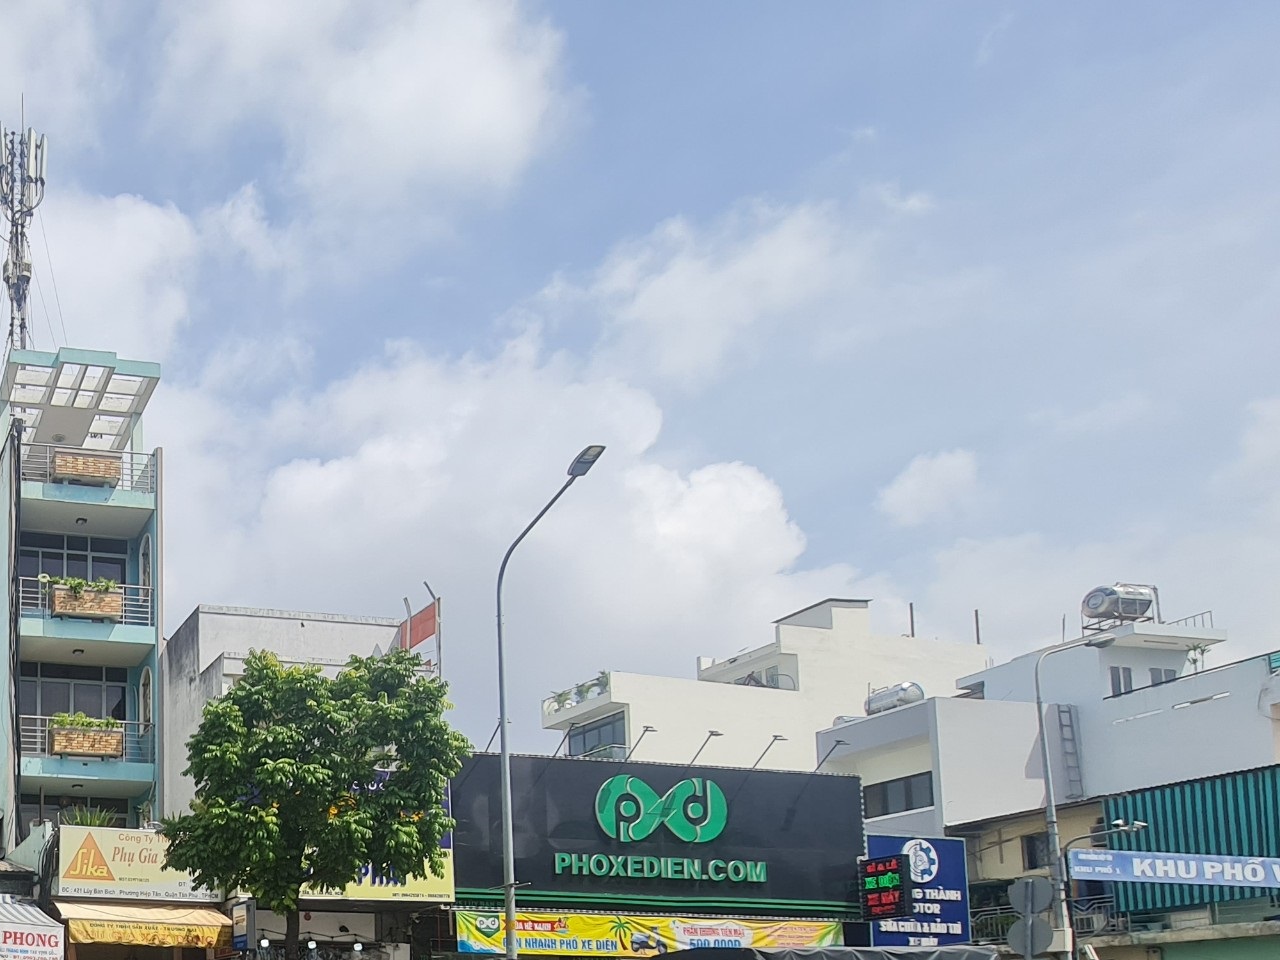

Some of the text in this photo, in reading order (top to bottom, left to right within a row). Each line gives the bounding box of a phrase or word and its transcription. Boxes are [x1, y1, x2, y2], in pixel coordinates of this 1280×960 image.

[118, 833, 141, 844] Công
[144, 835, 153, 844] Ty
[71, 849, 109, 877] Sika
[112, 847, 135, 867] Phụ
[139, 848, 158, 864] Gia
[554, 852, 768, 882] PHOXEDIEN.COM
[1132, 857, 1197, 879] KHU
[1203, 858, 1266, 882] PHỐ
[924, 885, 961, 901] THÀNH
[912, 902, 941, 914] OTOR
[2, 930, 60, 948] PHONG
[524, 937, 556, 949] NHANH
[581, 938, 593, 950] XE
